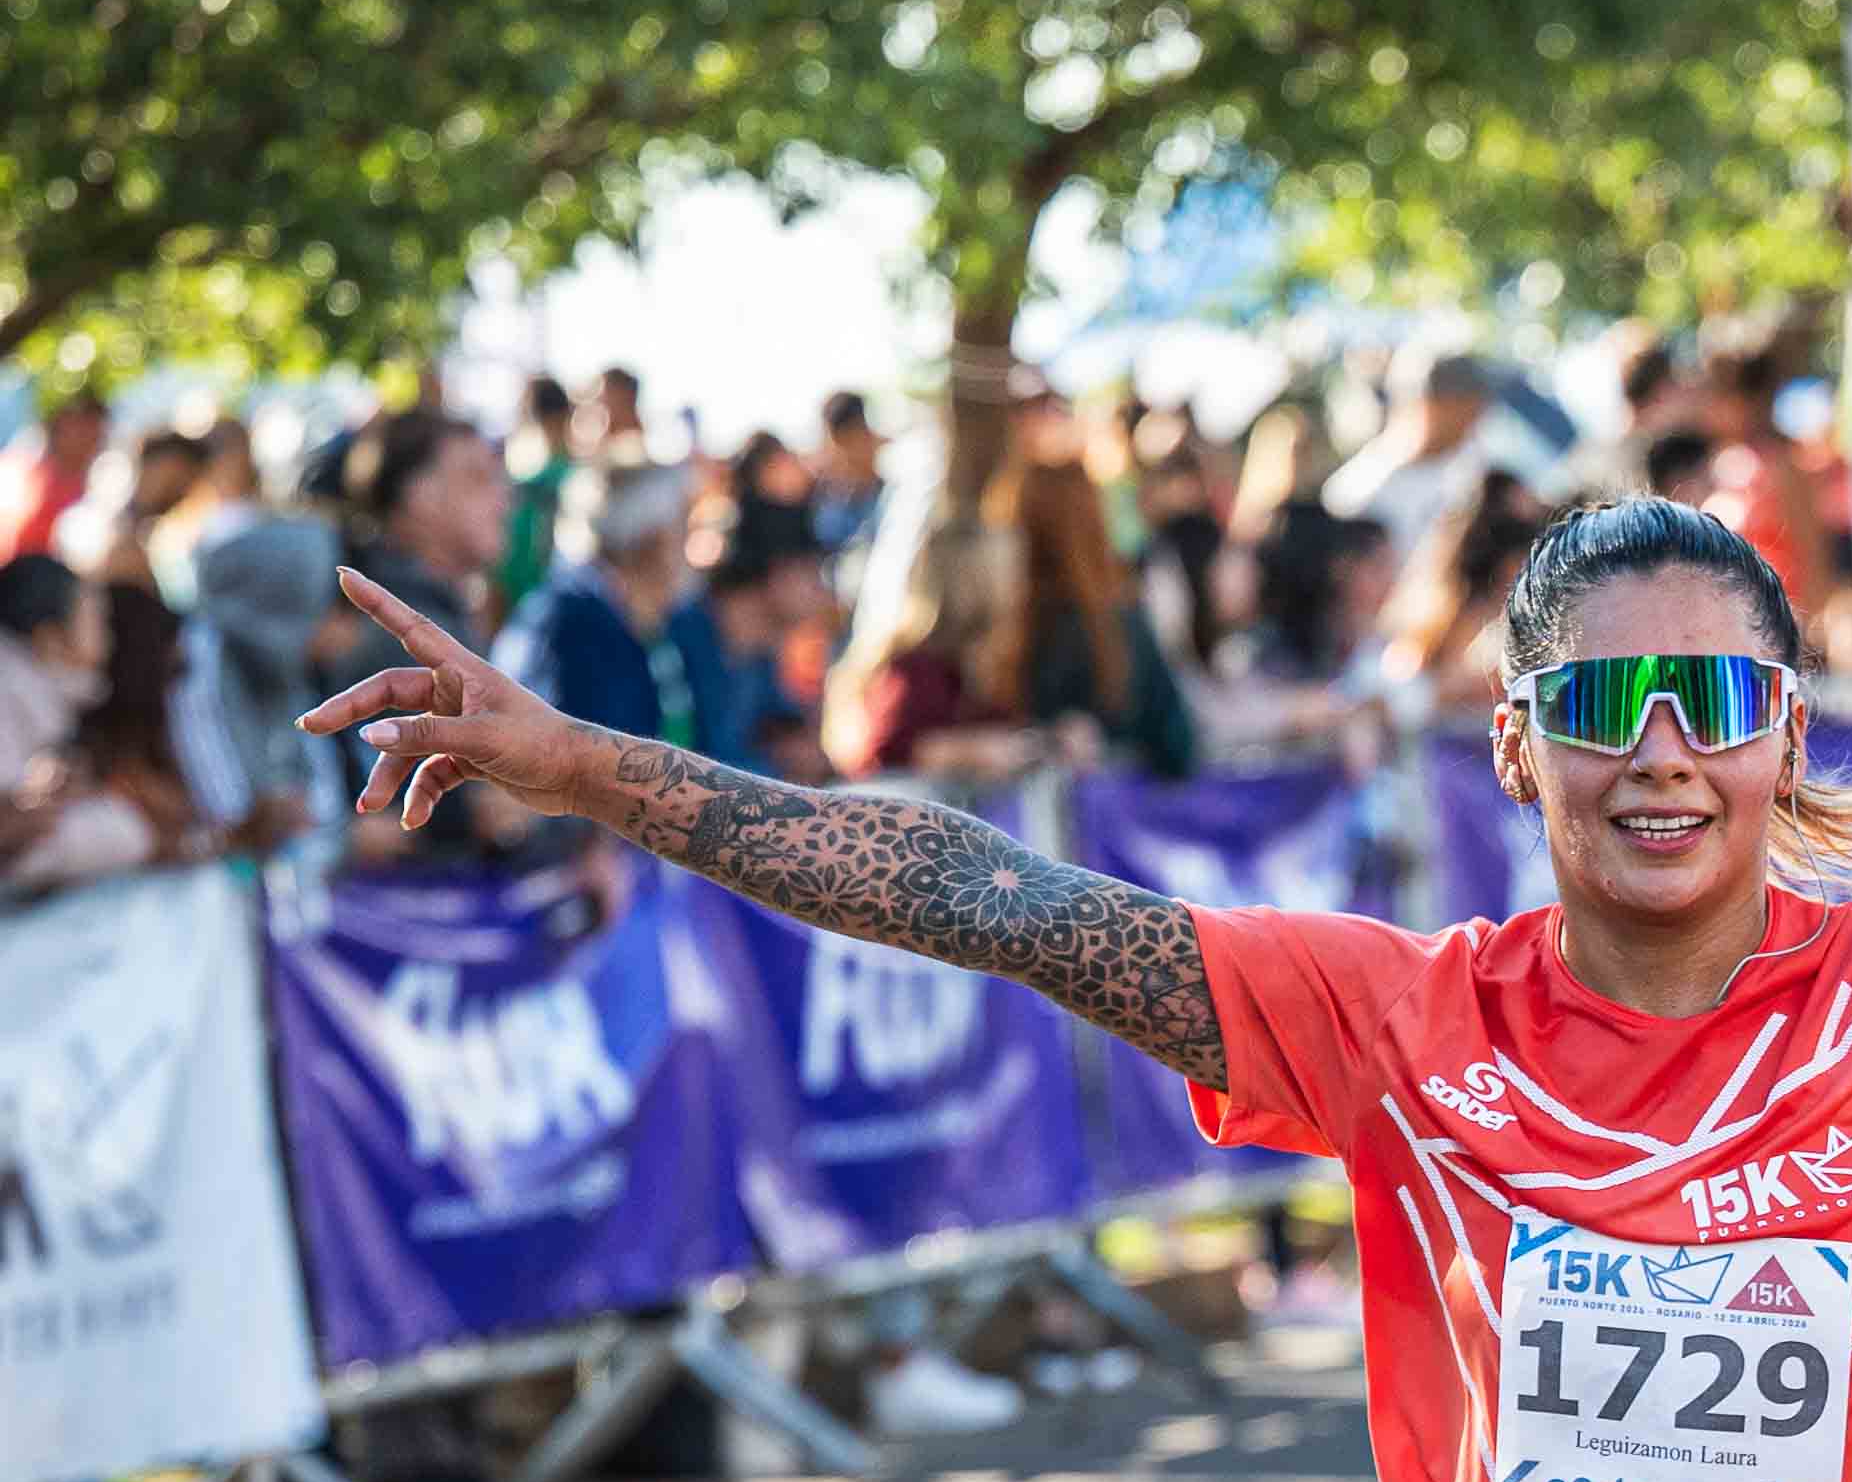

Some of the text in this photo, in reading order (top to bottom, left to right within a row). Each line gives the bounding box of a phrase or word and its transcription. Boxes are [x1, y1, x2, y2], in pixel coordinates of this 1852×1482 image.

[1680, 1154, 1801, 1229] 15K
[1698, 1210, 1806, 1244] PUERTO
[1542, 1248, 1633, 1298] 15K
[1538, 1295, 1579, 1307] PUERTO
[1582, 1300, 1617, 1312] NORTE
[1656, 1307, 1702, 1319] ROSARIO
[1747, 1317, 1778, 1327] ABRIL
[1747, 1281, 1795, 1307] 15K
[1517, 1319, 1830, 1438] 1729
[1575, 1430, 1759, 1467] Leguizamon Laura
